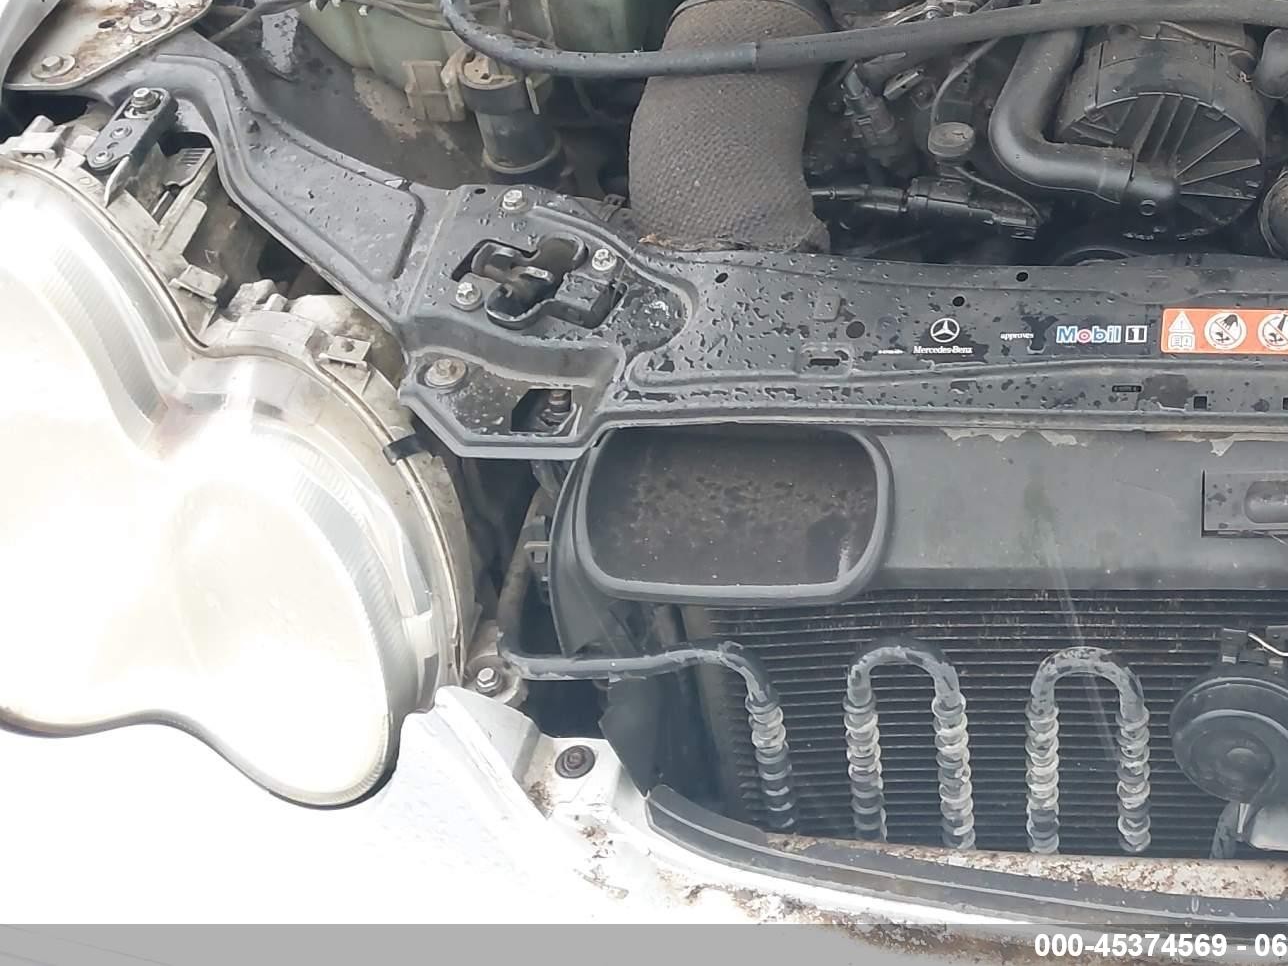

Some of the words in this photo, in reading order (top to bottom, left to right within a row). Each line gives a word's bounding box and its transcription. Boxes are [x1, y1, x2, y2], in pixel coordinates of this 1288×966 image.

[1056, 325, 1122, 343] Mobil
[1125, 325, 1148, 343] 1
[913, 345, 974, 354] Mercedes-Benz
